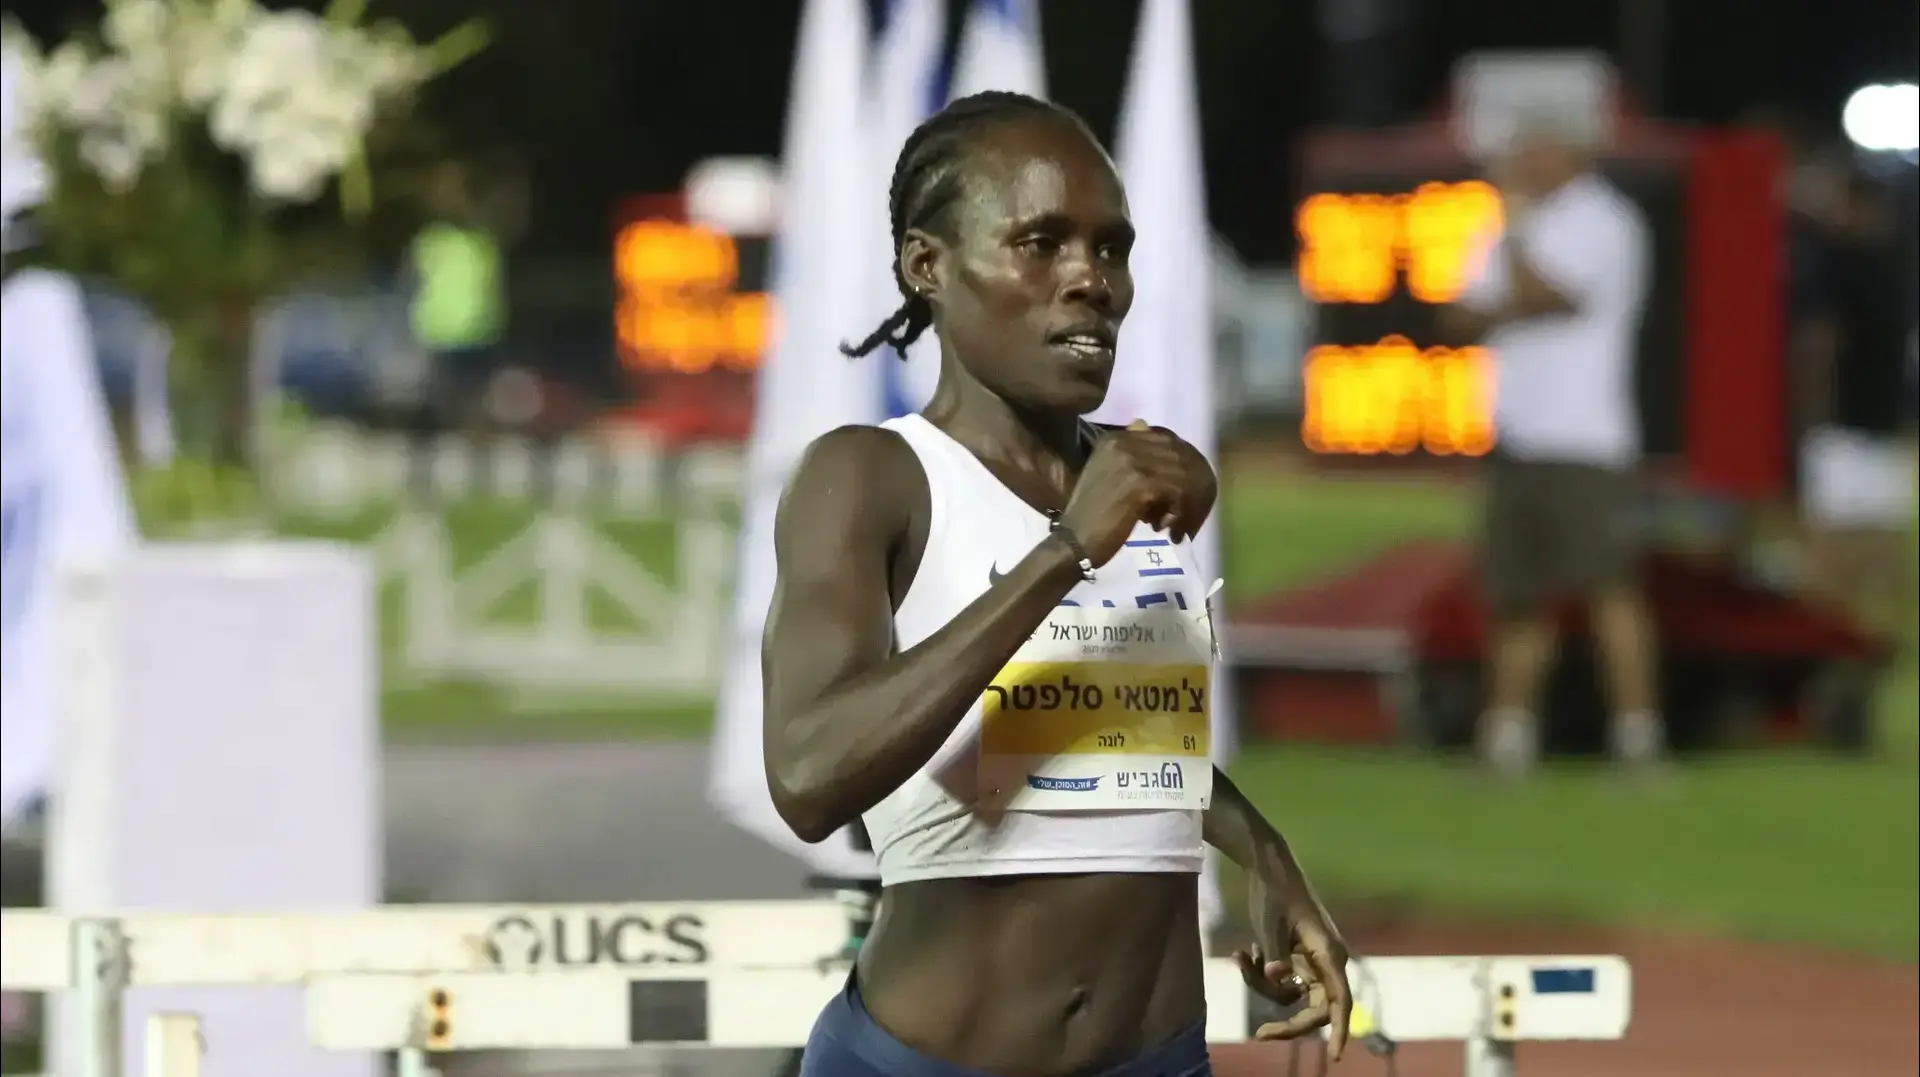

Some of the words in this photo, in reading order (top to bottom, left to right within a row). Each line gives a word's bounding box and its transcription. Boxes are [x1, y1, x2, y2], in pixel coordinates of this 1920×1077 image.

[1050, 621, 1097, 641] ישראל
[1102, 623, 1155, 642] אליפות
[986, 675, 1103, 711] סלפטר
[1115, 677, 1204, 713] צ'מטאי
[1183, 735, 1196, 751] 61
[553, 915, 708, 964] UCS
